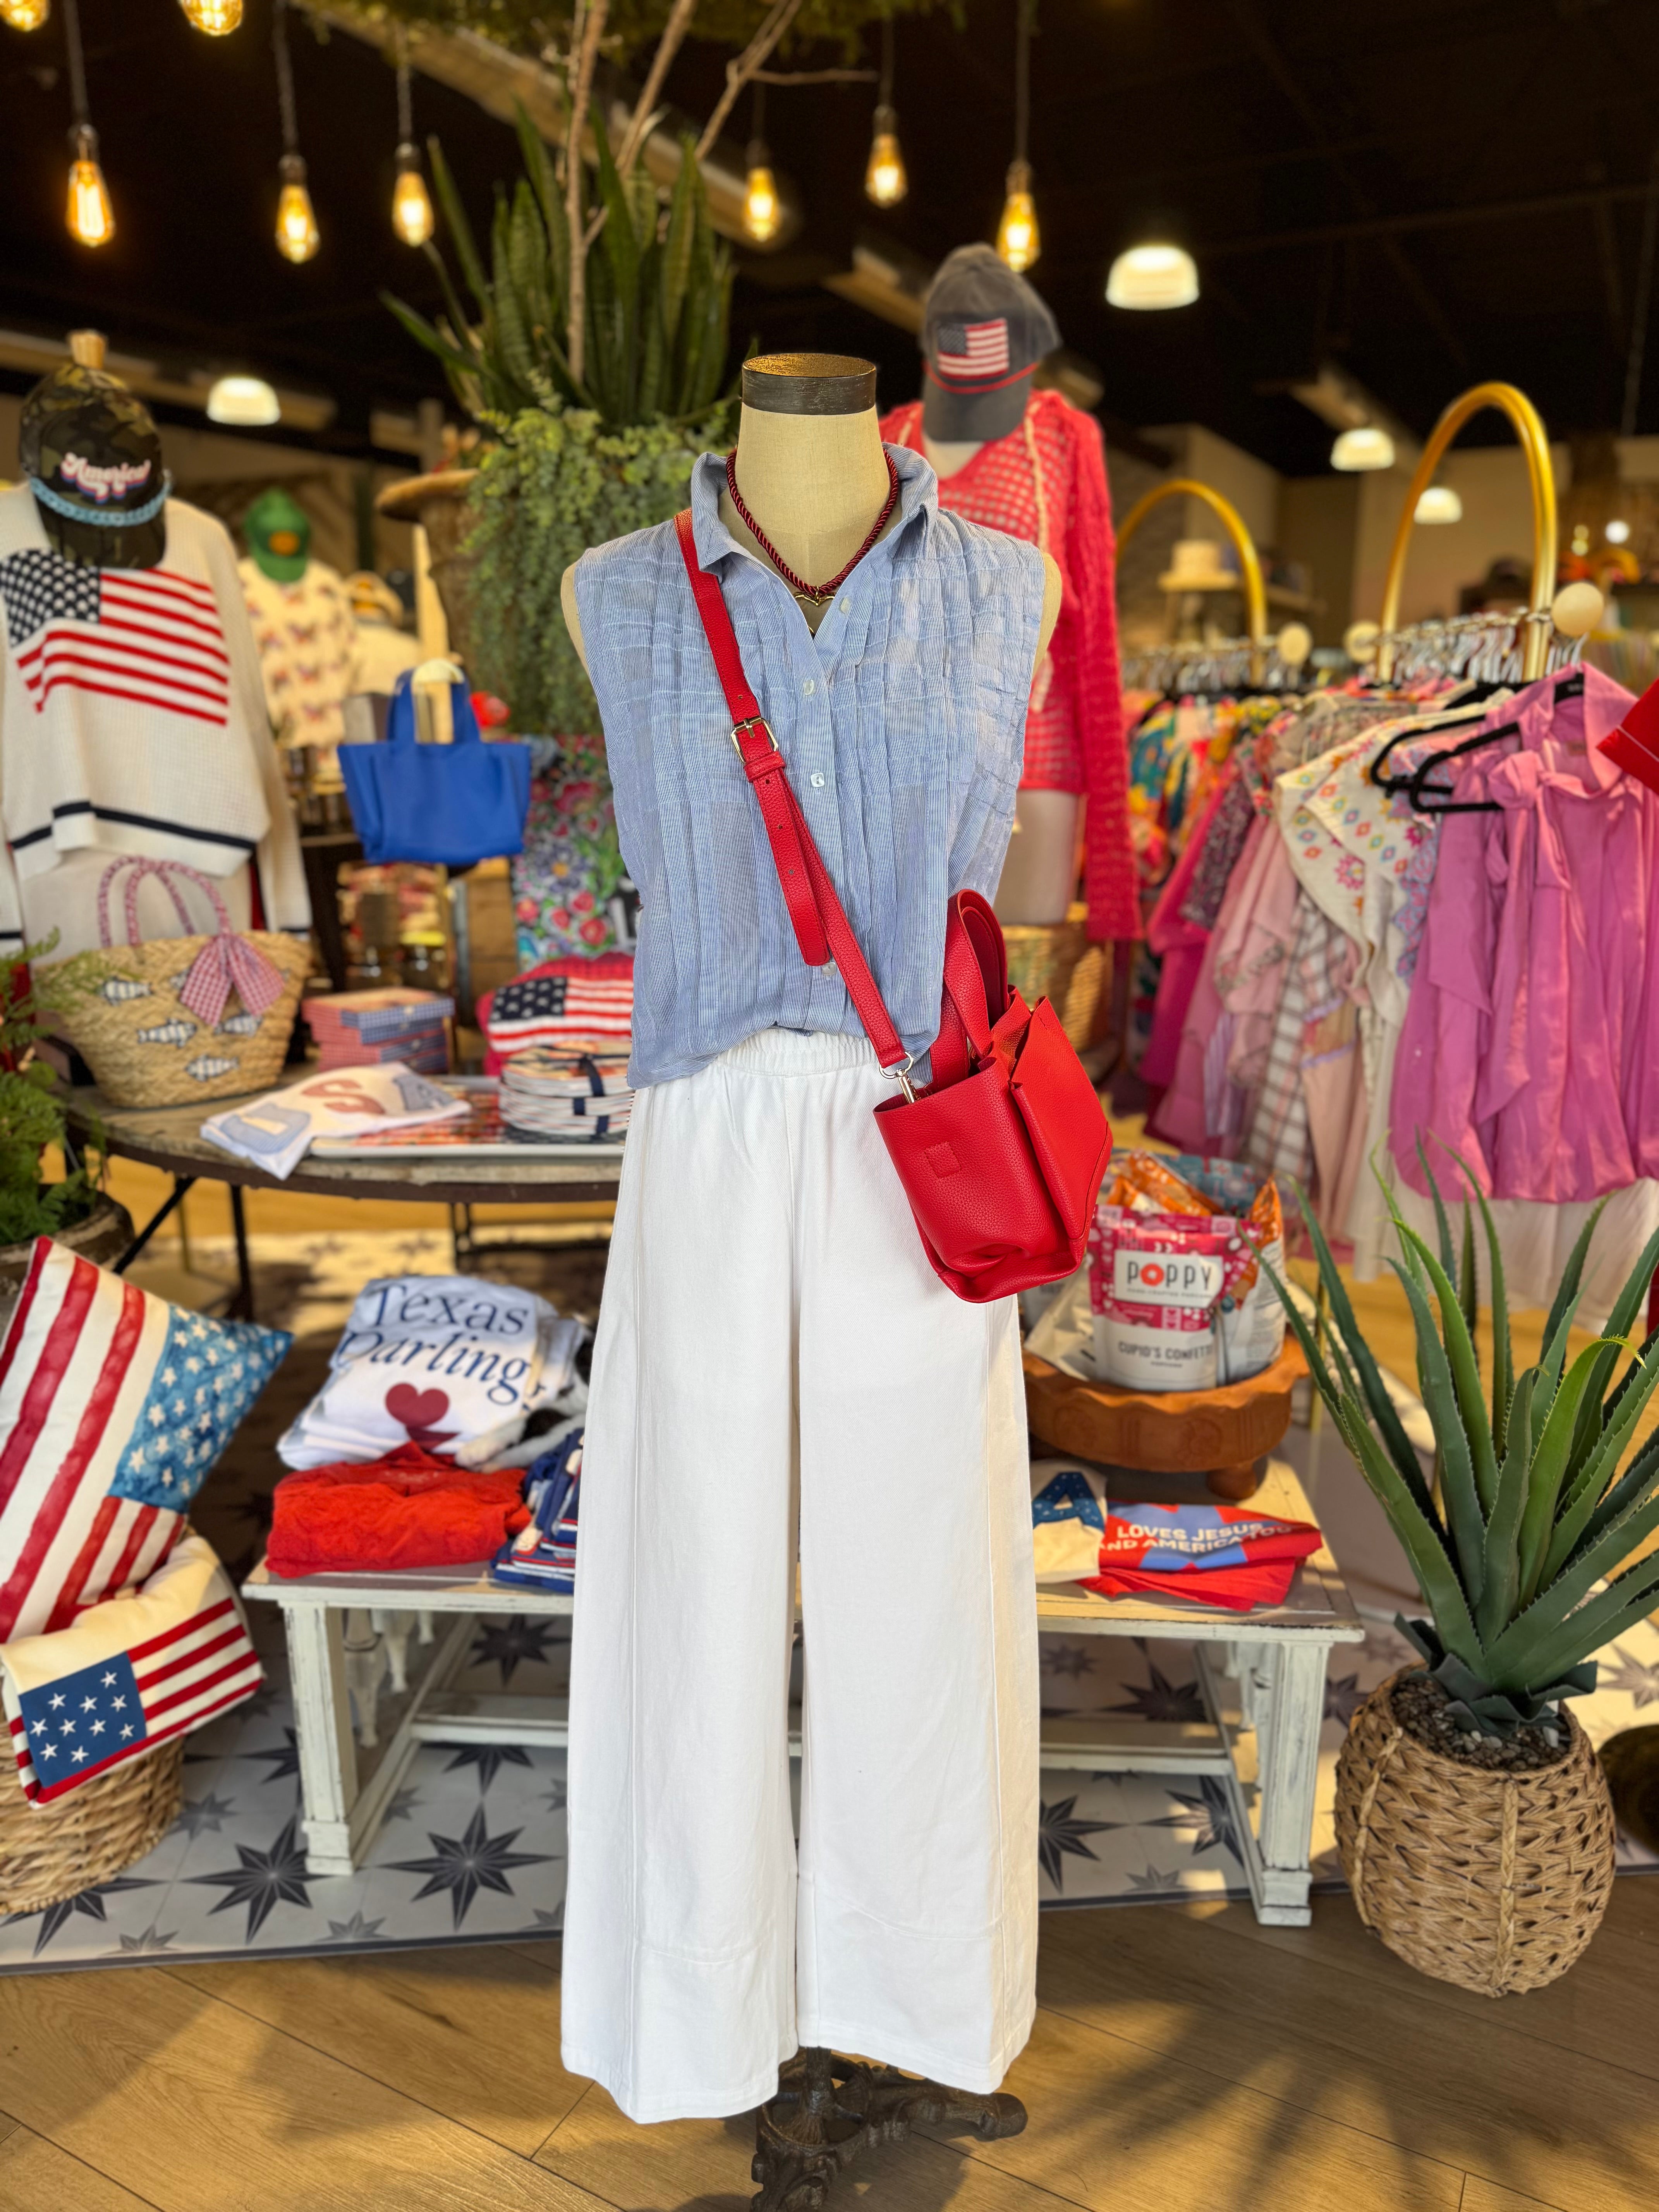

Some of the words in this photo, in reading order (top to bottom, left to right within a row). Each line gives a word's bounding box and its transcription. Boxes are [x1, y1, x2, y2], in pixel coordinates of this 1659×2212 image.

[1127, 1261, 1212, 1290] POPPY
[366, 1283, 528, 1335] Texas
[336, 1331, 532, 1406] Darling
[1117, 1524, 1187, 1540] LOVES
[1191, 1522, 1265, 1542] JESUS
[1142, 1538, 1243, 1553] AMERICA
